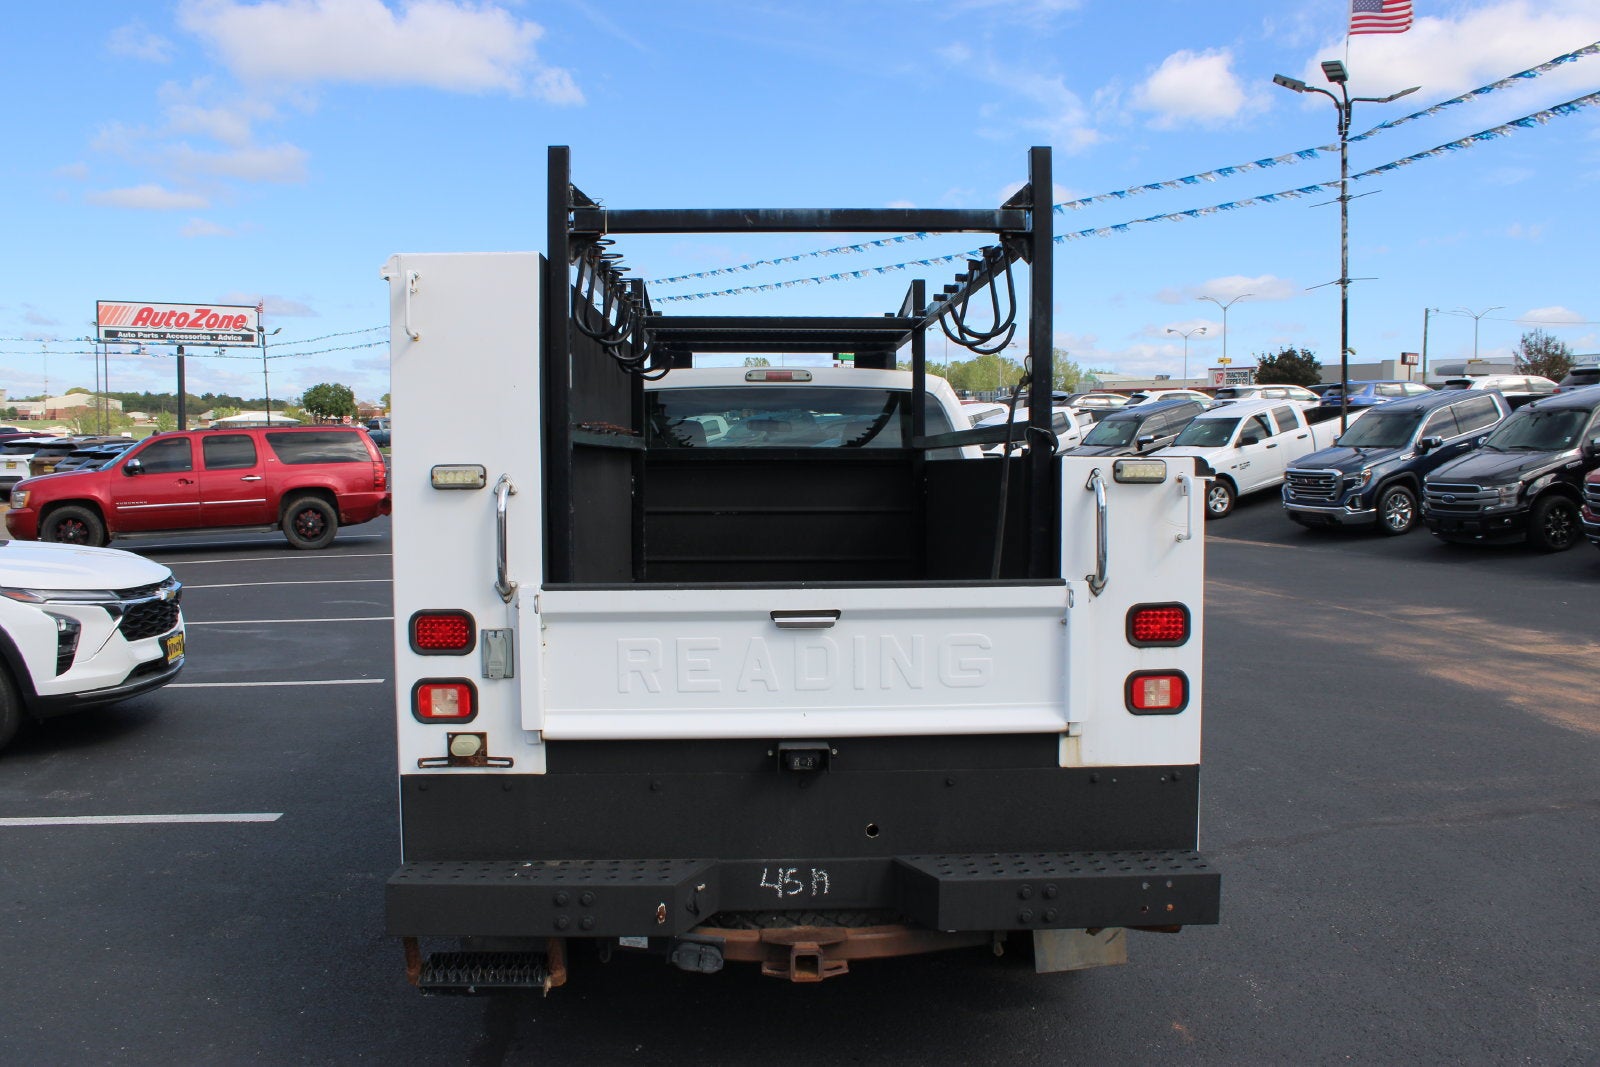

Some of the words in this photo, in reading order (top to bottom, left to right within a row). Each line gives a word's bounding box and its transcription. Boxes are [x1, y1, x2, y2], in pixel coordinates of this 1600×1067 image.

[131, 306, 247, 329] AutoZone
[165, 333, 211, 341] Accessories
[616, 633, 995, 694] READING
